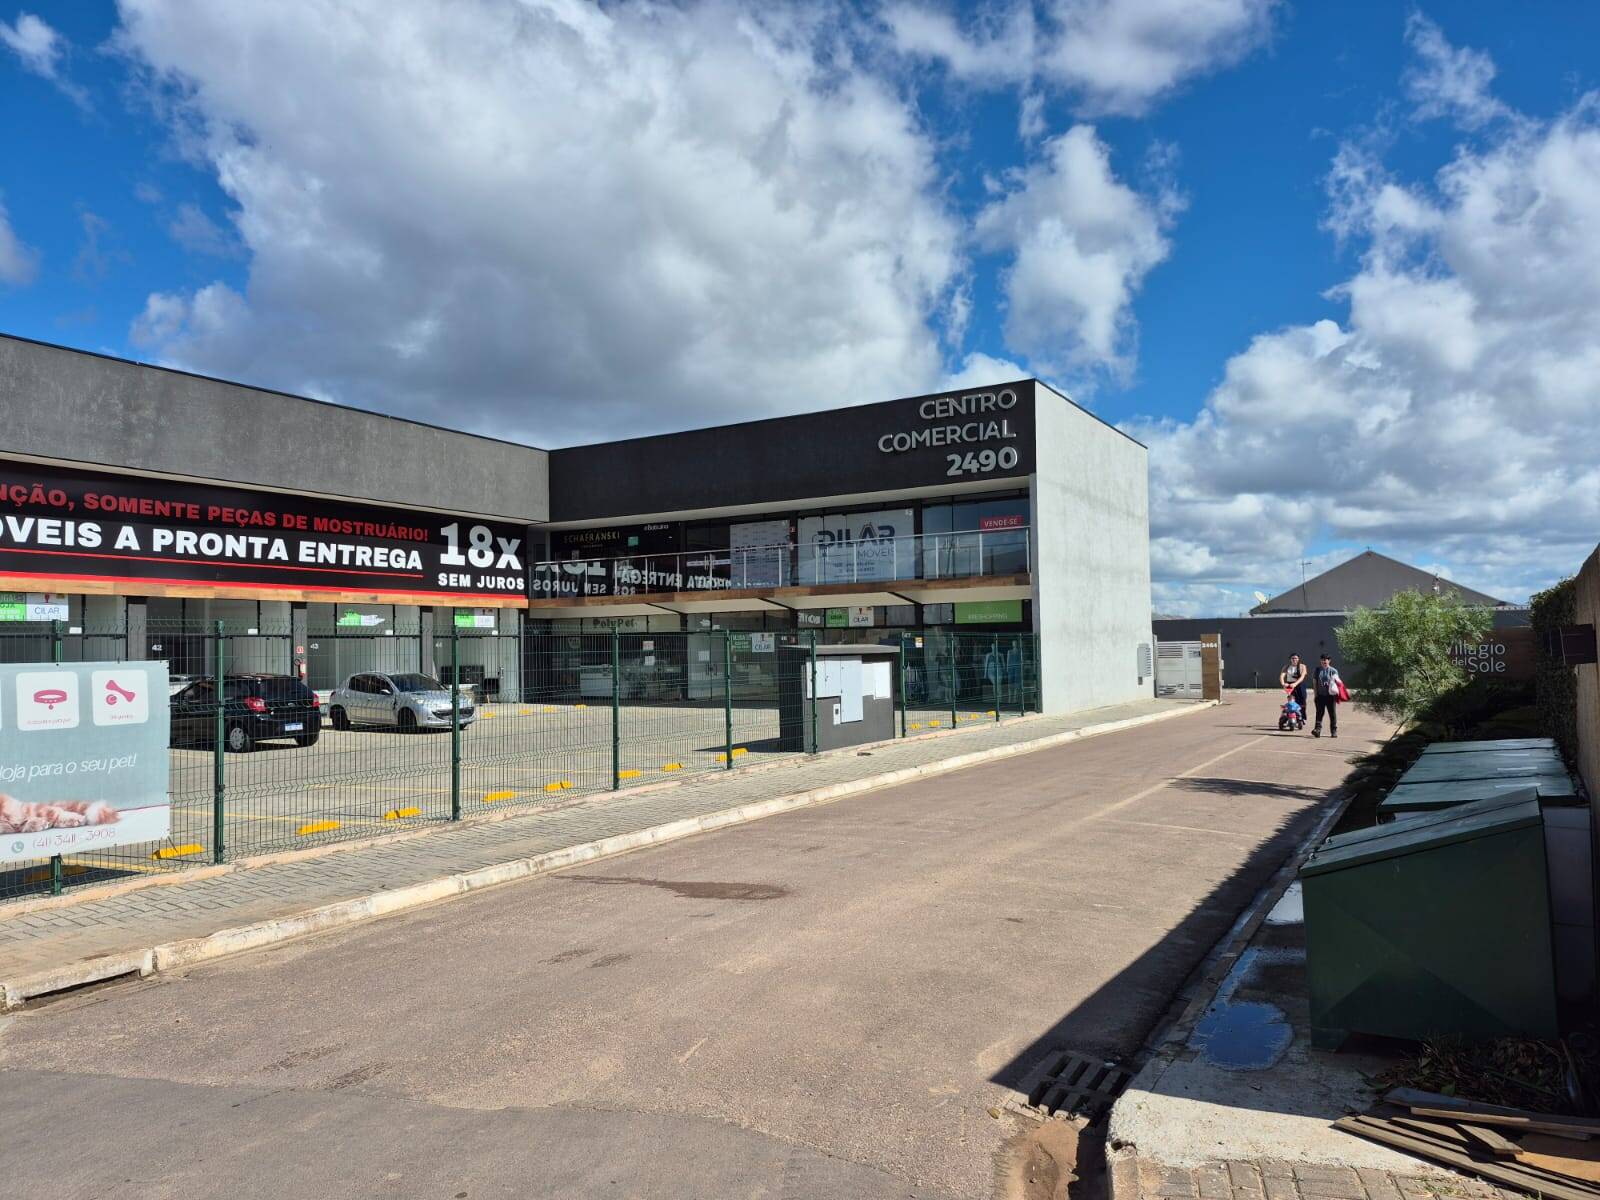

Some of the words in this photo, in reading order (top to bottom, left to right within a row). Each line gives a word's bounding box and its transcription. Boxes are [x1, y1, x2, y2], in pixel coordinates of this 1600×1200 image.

[919, 389, 1017, 419] CENTRO
[878, 420, 1017, 452] COMERCIAL
[946, 446, 1018, 476] 2490
[83, 493, 200, 519] SOMENTE
[208, 506, 276, 527] PEÇAS
[282, 514, 307, 529] DE
[313, 517, 428, 541] MOSTRUÁRIO!
[985, 518, 1017, 528] VENDE-SE
[0, 515, 102, 548] VEIS
[114, 525, 141, 550] A
[153, 528, 289, 560] PRONTA
[299, 540, 423, 570] ENTREGA
[440, 522, 522, 570] 18x
[438, 572, 471, 588] SEM
[477, 575, 525, 590] JUROS
[1452, 657, 1467, 666] del
[1467, 657, 1506, 673] Sole
[27, 761, 63, 783] para
[65, 761, 78, 774] o
[80, 757, 107, 773] seu
[107, 753, 137, 774] pet!
